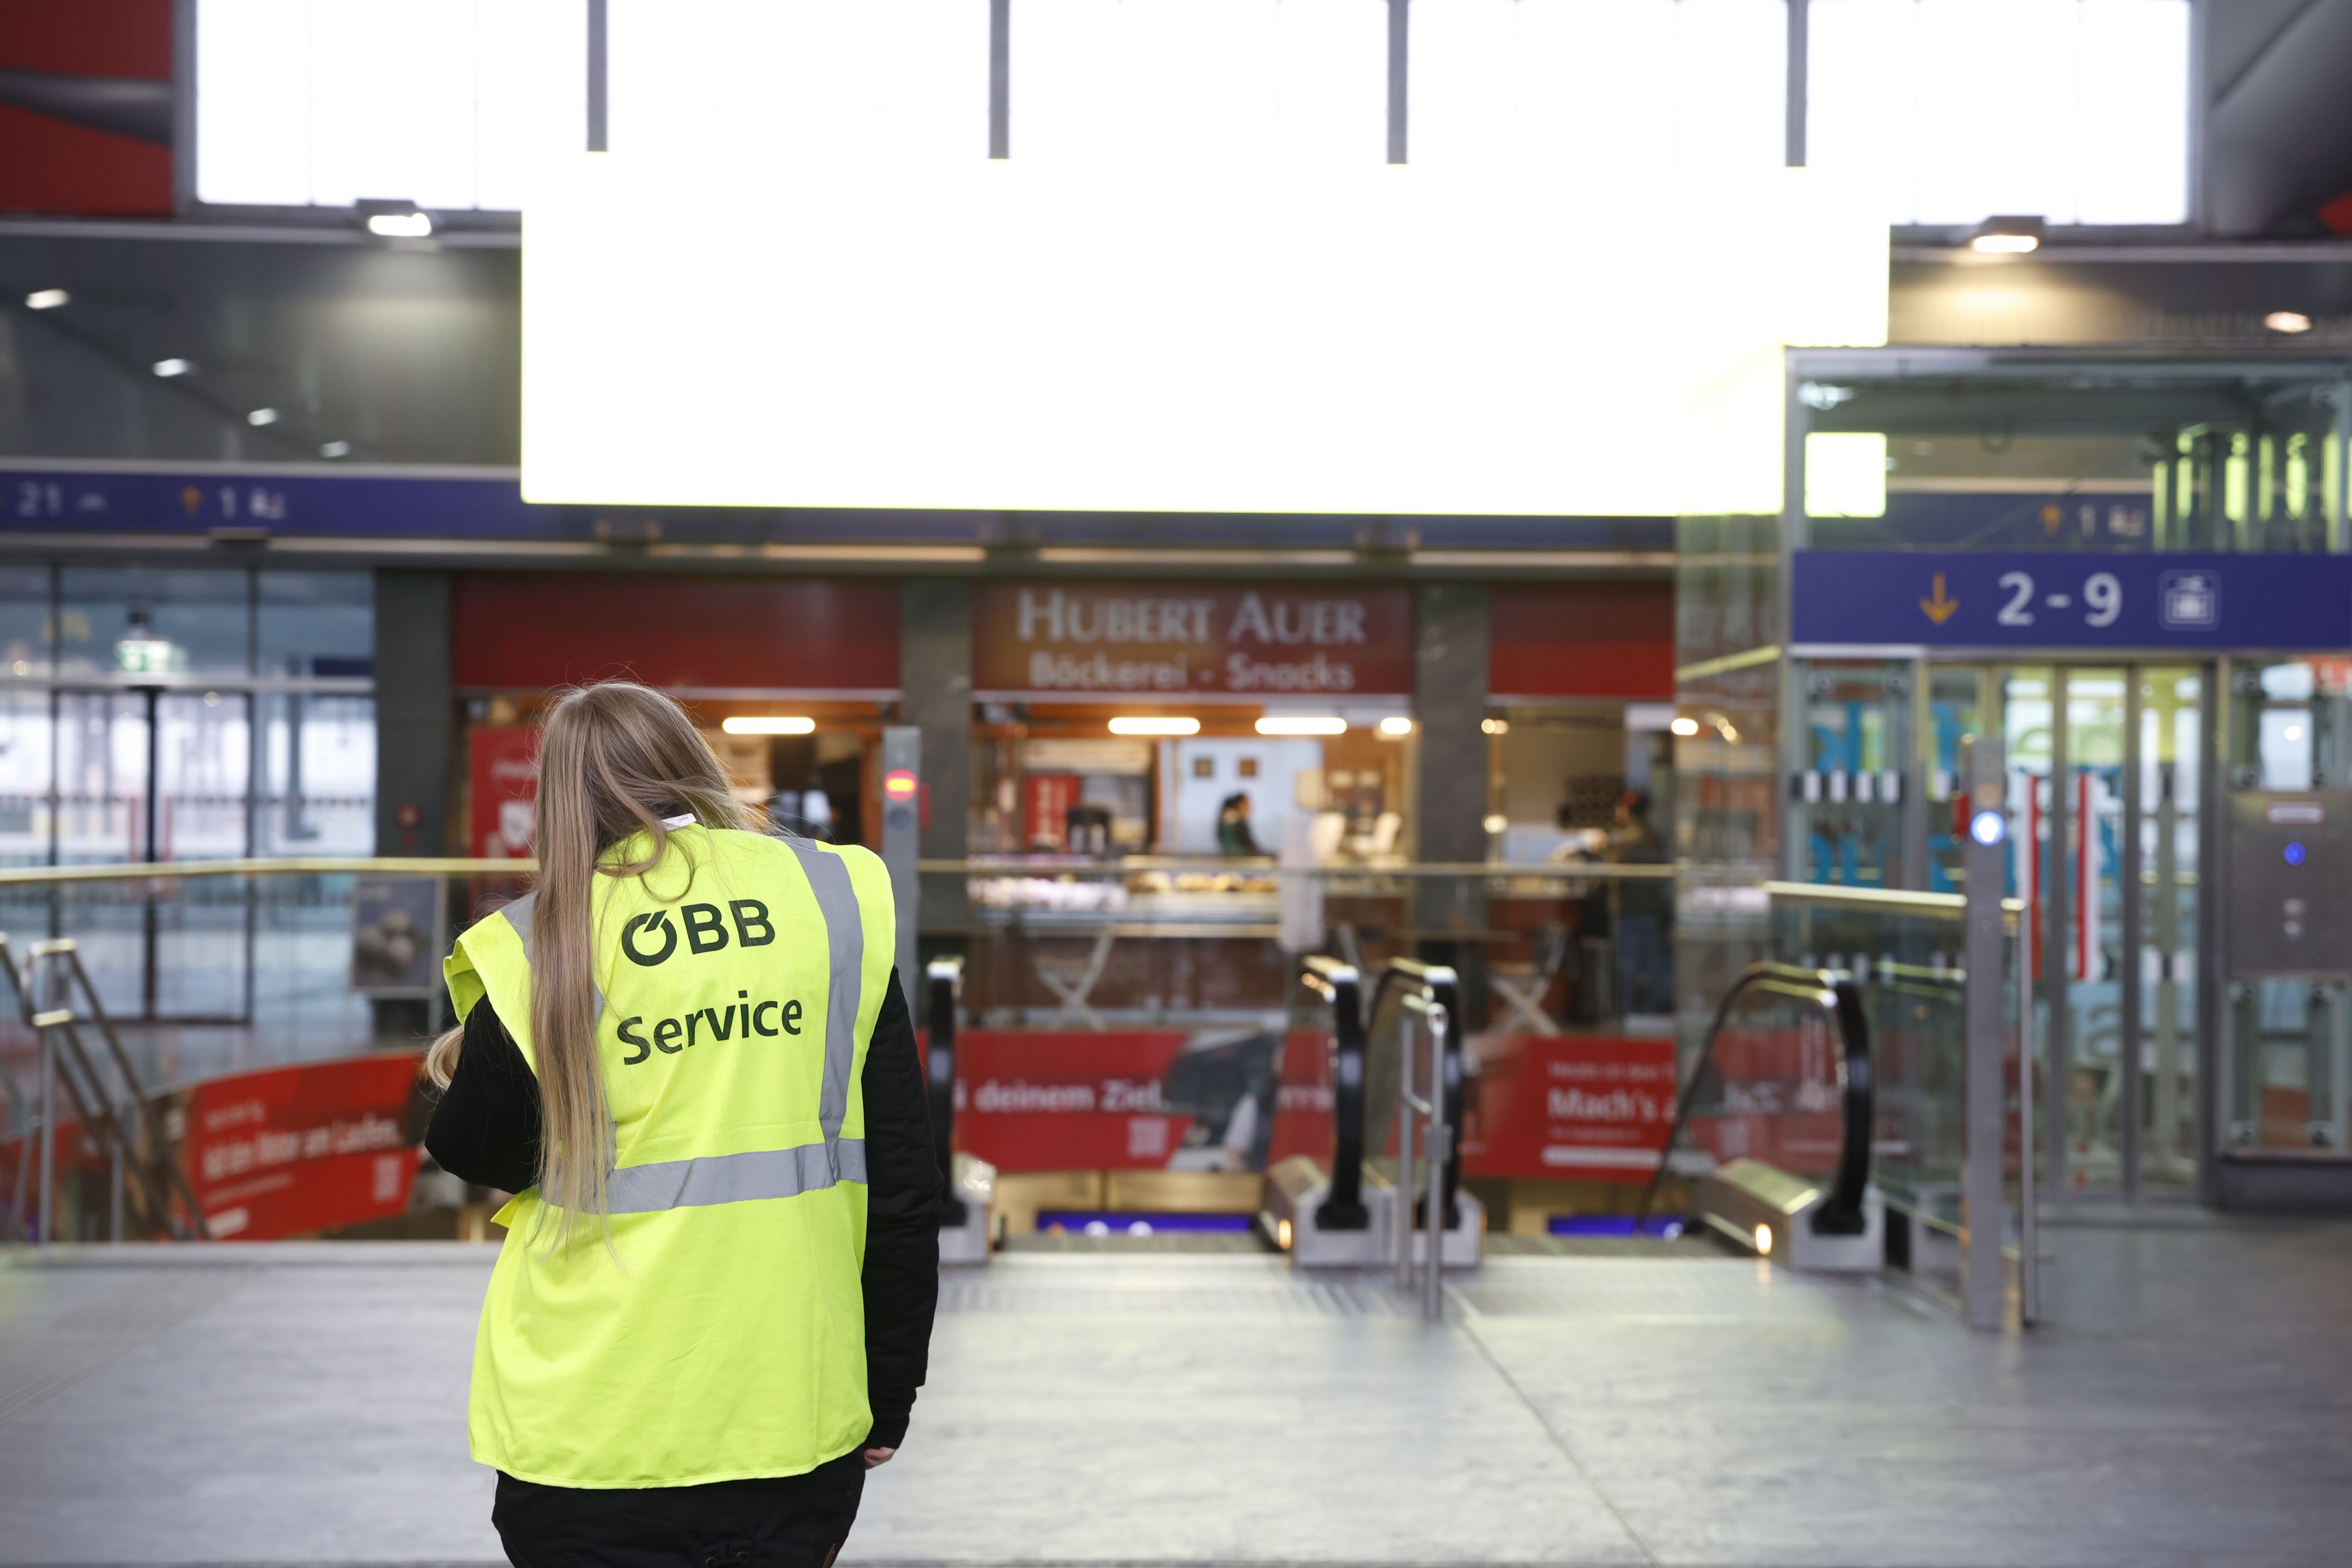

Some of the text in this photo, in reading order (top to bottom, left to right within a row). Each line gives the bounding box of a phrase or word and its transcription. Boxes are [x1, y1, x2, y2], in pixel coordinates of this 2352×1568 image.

[1226, 653, 1354, 689] Snacks
[617, 990, 802, 1065] Service
[975, 1078, 1094, 1113] deinem
[1548, 1087, 1658, 1123] Mach's
